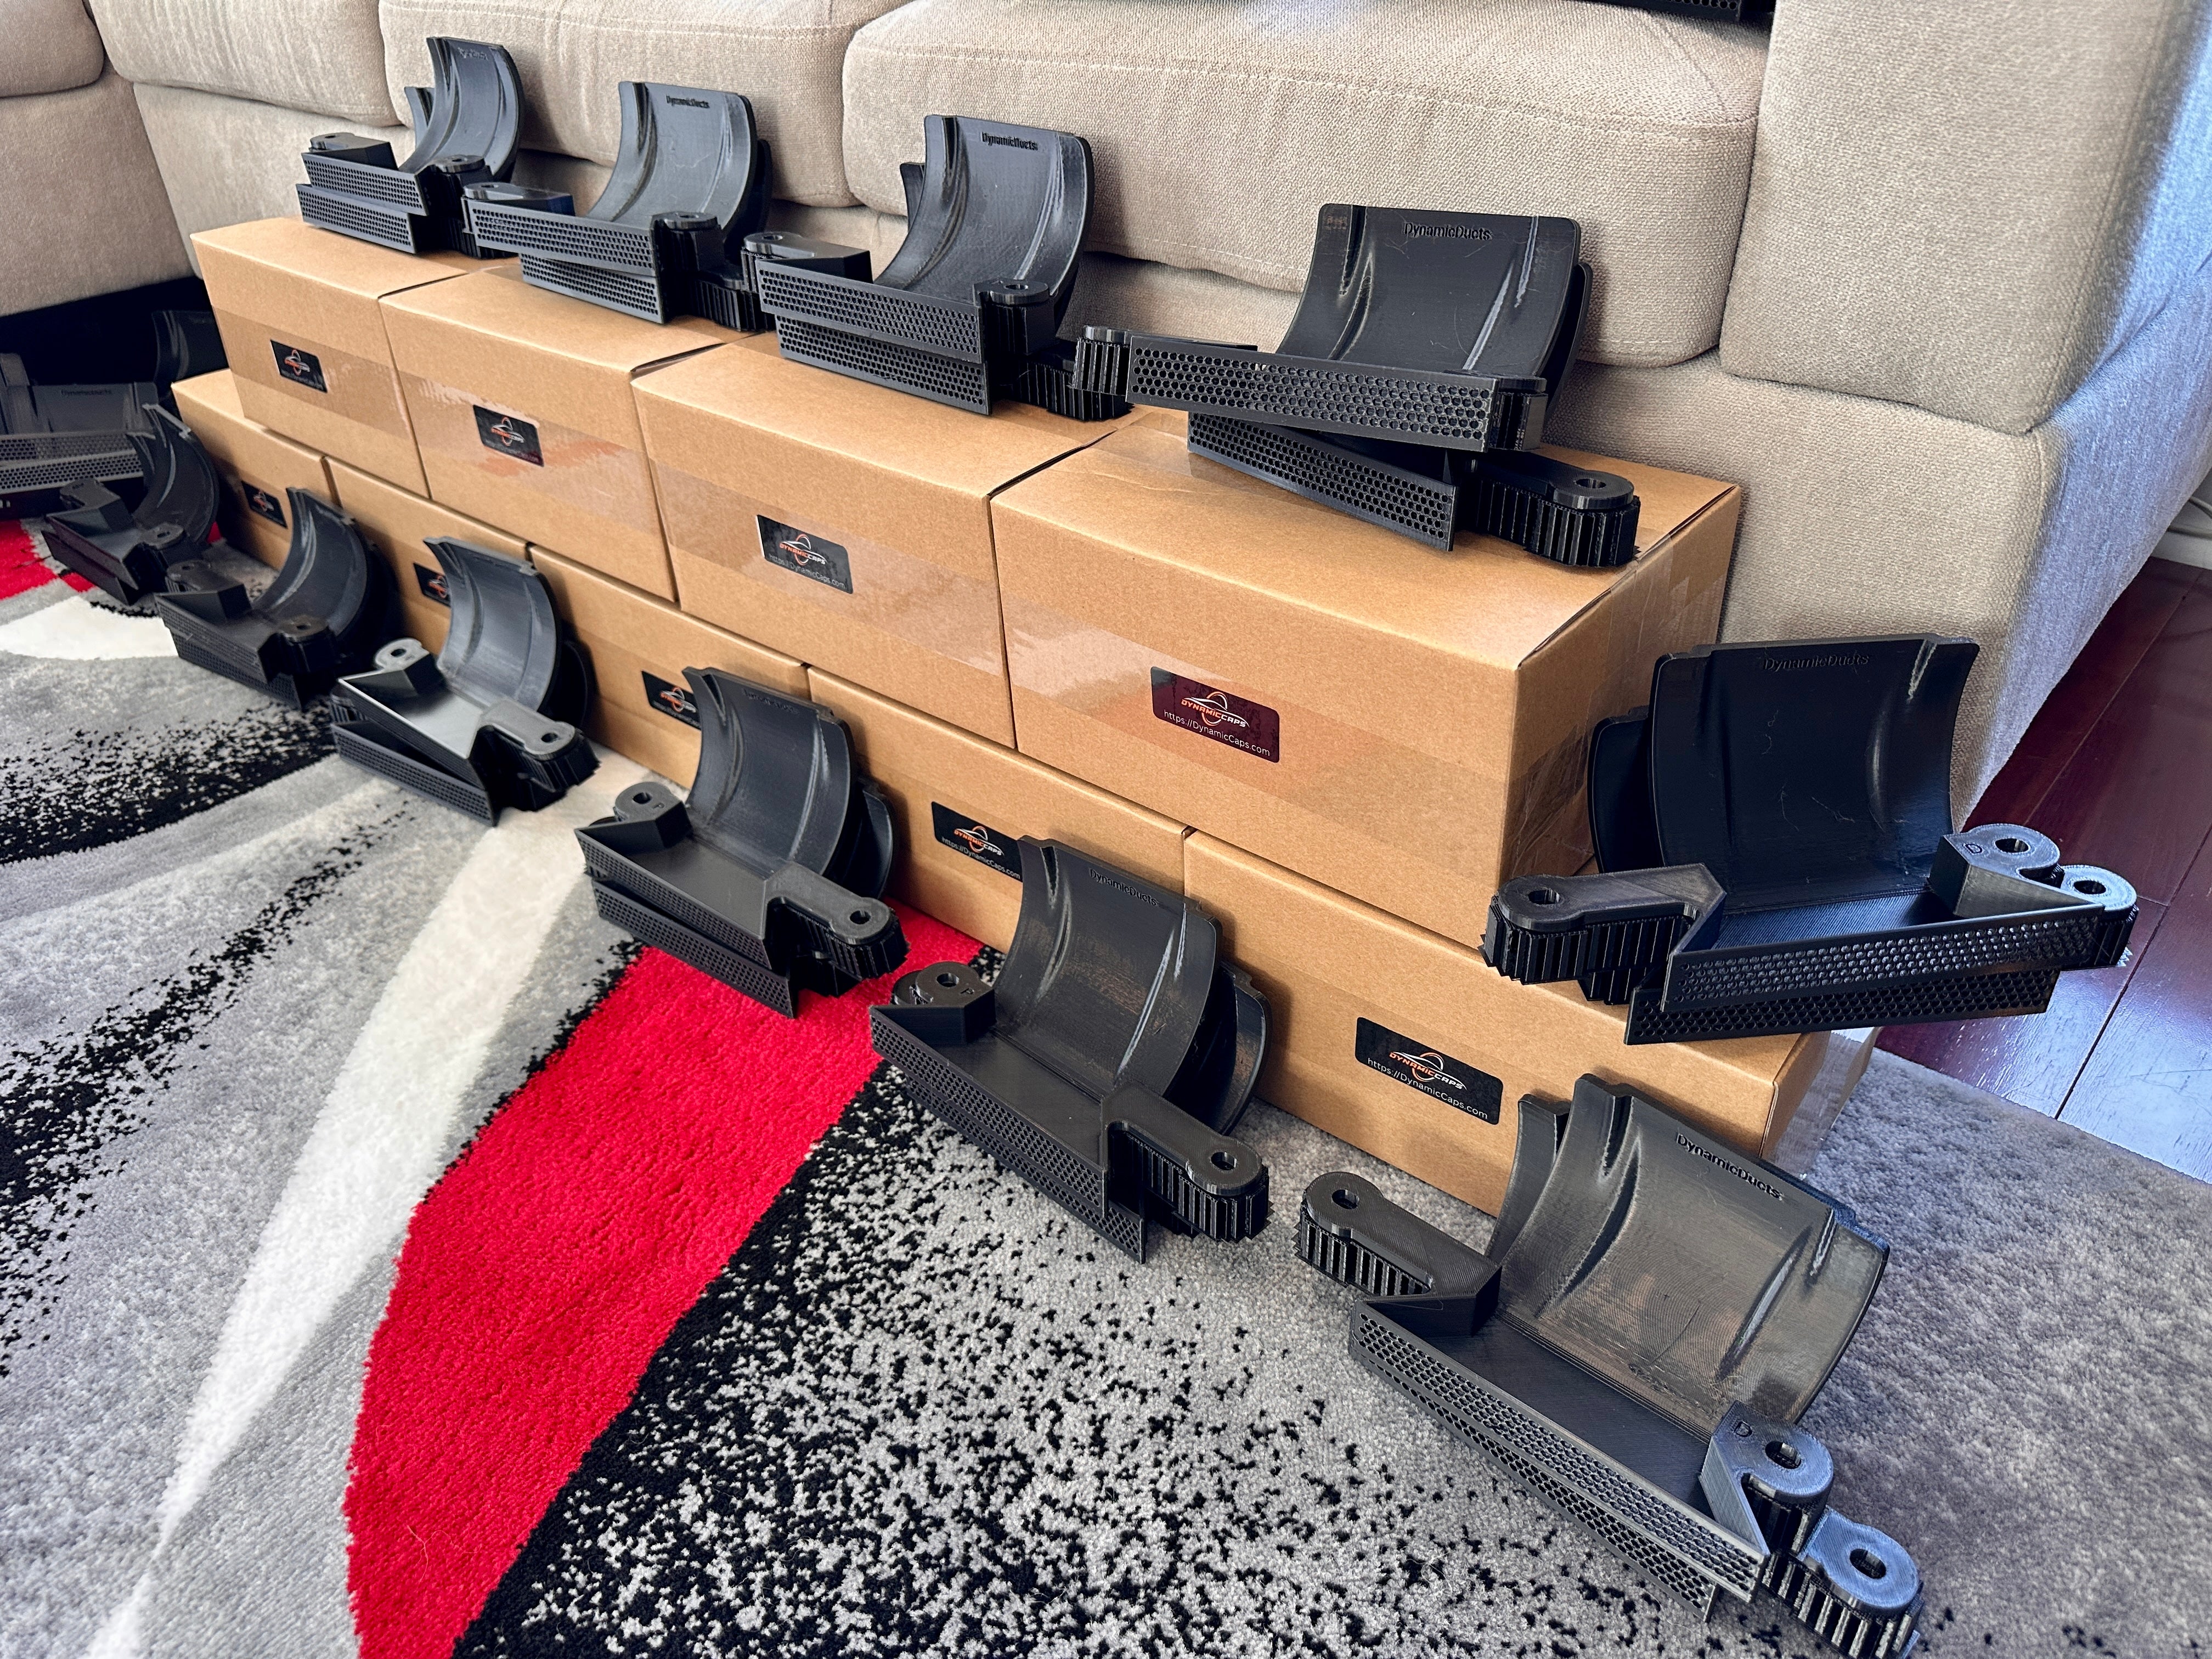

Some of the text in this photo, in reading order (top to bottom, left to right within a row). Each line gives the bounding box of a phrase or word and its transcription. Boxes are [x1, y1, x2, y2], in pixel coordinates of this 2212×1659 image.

[981, 132, 1038, 151] DynamicDucts
[1404, 222, 1493, 240] DynamicDucts
[779, 543, 826, 565] DYNAMICCAPS
[1181, 699, 1246, 727] DYNAMICCAPS
[1164, 709, 1271, 757] https://DynamicCaps.com
[953, 830, 1002, 856] DYNAMICCAPS
[1090, 868, 1158, 907] DynamicDucts
[1389, 1052, 1463, 1090] DYNAMICCAPS
[1367, 1057, 1488, 1120] https://DynamicCaps.com
[1677, 1134, 1784, 1201] DynamicDucts
